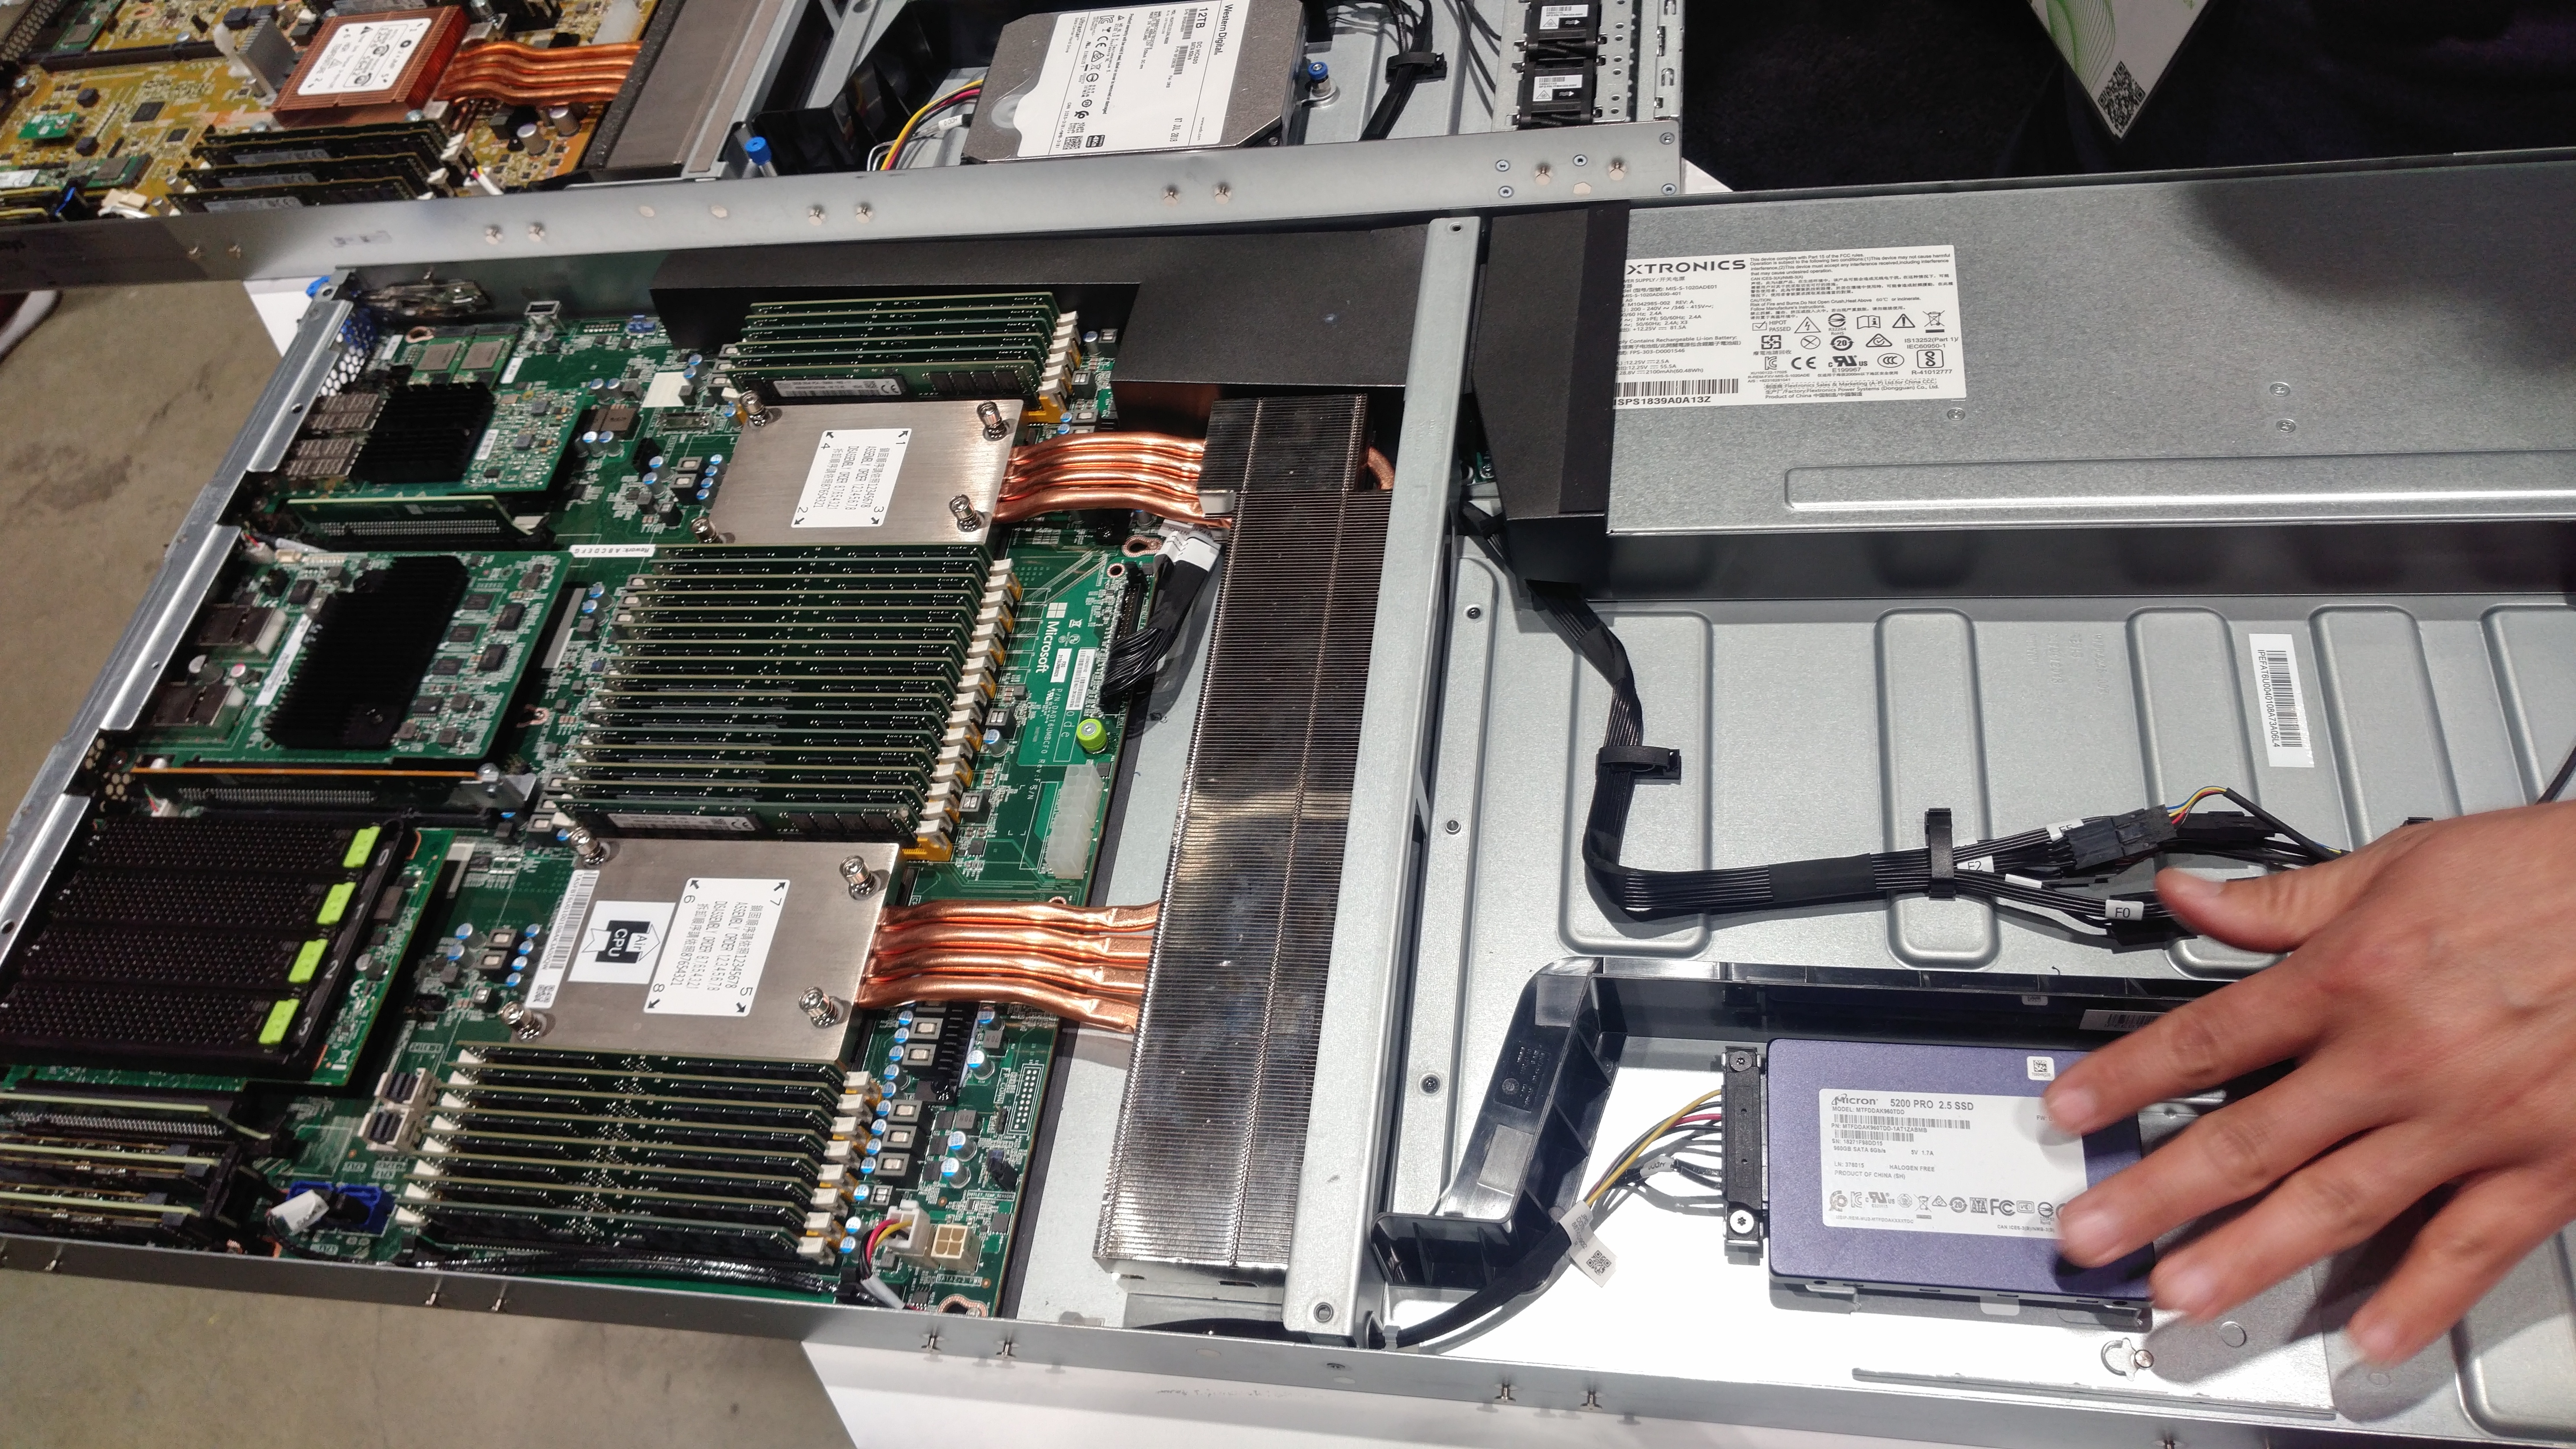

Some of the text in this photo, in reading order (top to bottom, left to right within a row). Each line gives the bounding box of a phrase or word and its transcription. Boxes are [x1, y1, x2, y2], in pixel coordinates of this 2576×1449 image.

[1196, 8, 1208, 28] 12TB
[1220, 4, 1233, 31] Western
[1192, 49, 1201, 64] HC520
[1169, 133, 1179, 142] 2018
[1626, 260, 1745, 274] XTRONICS
[1791, 357, 1816, 370] CE
[1617, 396, 1711, 406] SPS1839A0A13Z
[860, 446, 876, 466] ASSEMBLY
[836, 446, 859, 483] DISASSEMBLY ORDER
[855, 469, 869, 481] ORDER
[1036, 621, 1059, 673] Microsoft
[684, 895, 695, 903] 6
[770, 897, 782, 906] 7
[2116, 908, 2130, 918] F0
[699, 901, 728, 953] DISASSEMBLY ORDER
[721, 902, 747, 951] ASSEMBLY ORDER
[609, 928, 628, 956] CPU
[633, 935, 647, 951] Air
[325, 960, 338, 979] 2
[653, 983, 664, 992] 8
[740, 987, 753, 996] 5
[299, 1017, 312, 1036] 3
[1832, 1094, 1876, 1105] Micron
[1890, 1099, 1974, 1110] 5200 PRO 2.5 SSD
